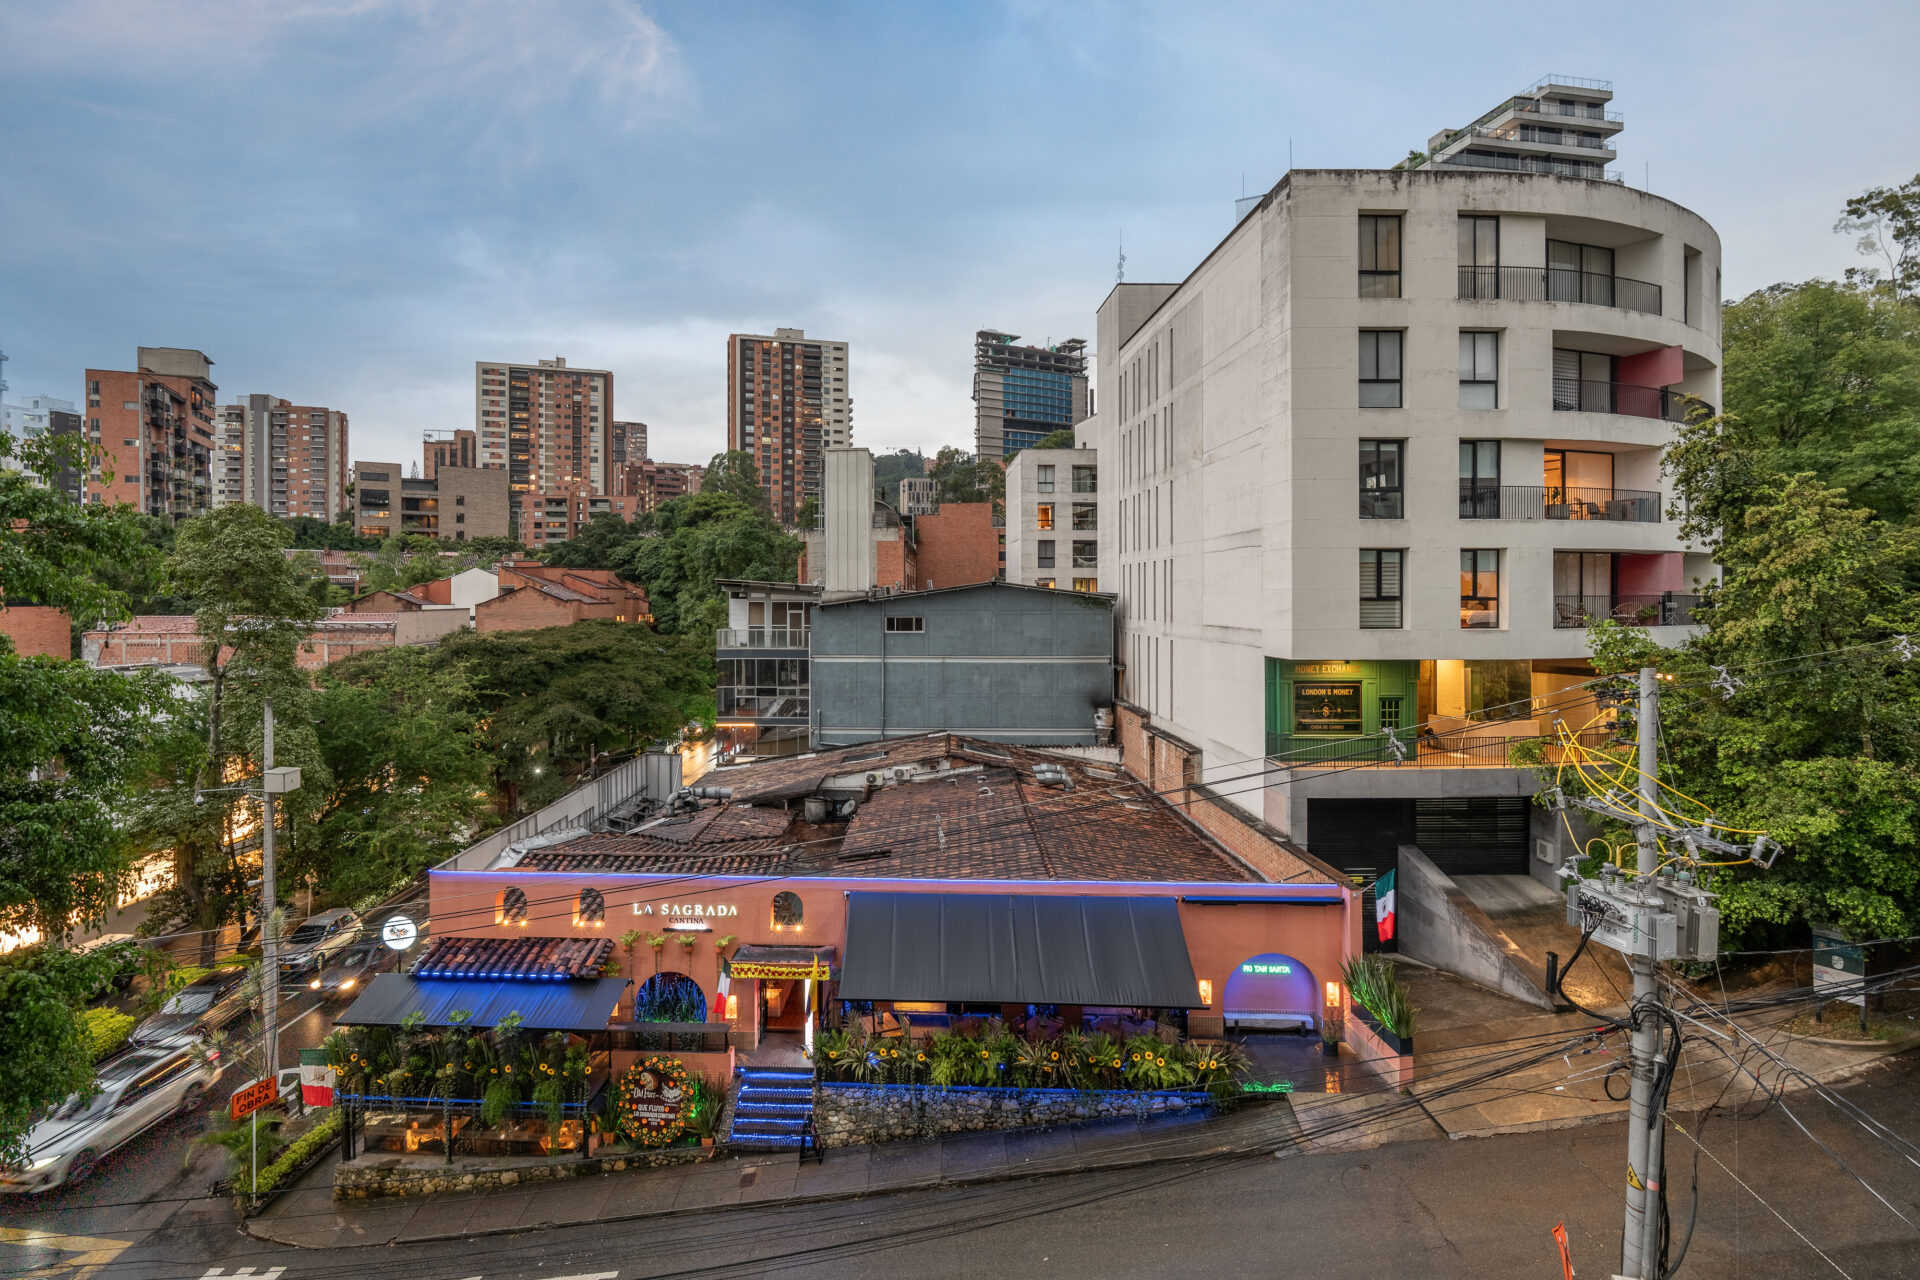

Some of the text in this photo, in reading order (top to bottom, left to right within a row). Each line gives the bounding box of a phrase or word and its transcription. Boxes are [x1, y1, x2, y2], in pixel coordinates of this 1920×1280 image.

[1295, 664, 1320, 674] MONEY
[1333, 688, 1354, 696] MONEY
[633, 903, 738, 916] LA SAGRADA
[1254, 964, 1268, 973] TAN
[1268, 965, 1291, 974] SANTA
[236, 1081, 272, 1104] FIN DE
[633, 1087, 643, 1098] Old
[239, 1093, 270, 1112] OBRA
[648, 1104, 664, 1112] FLUYA
